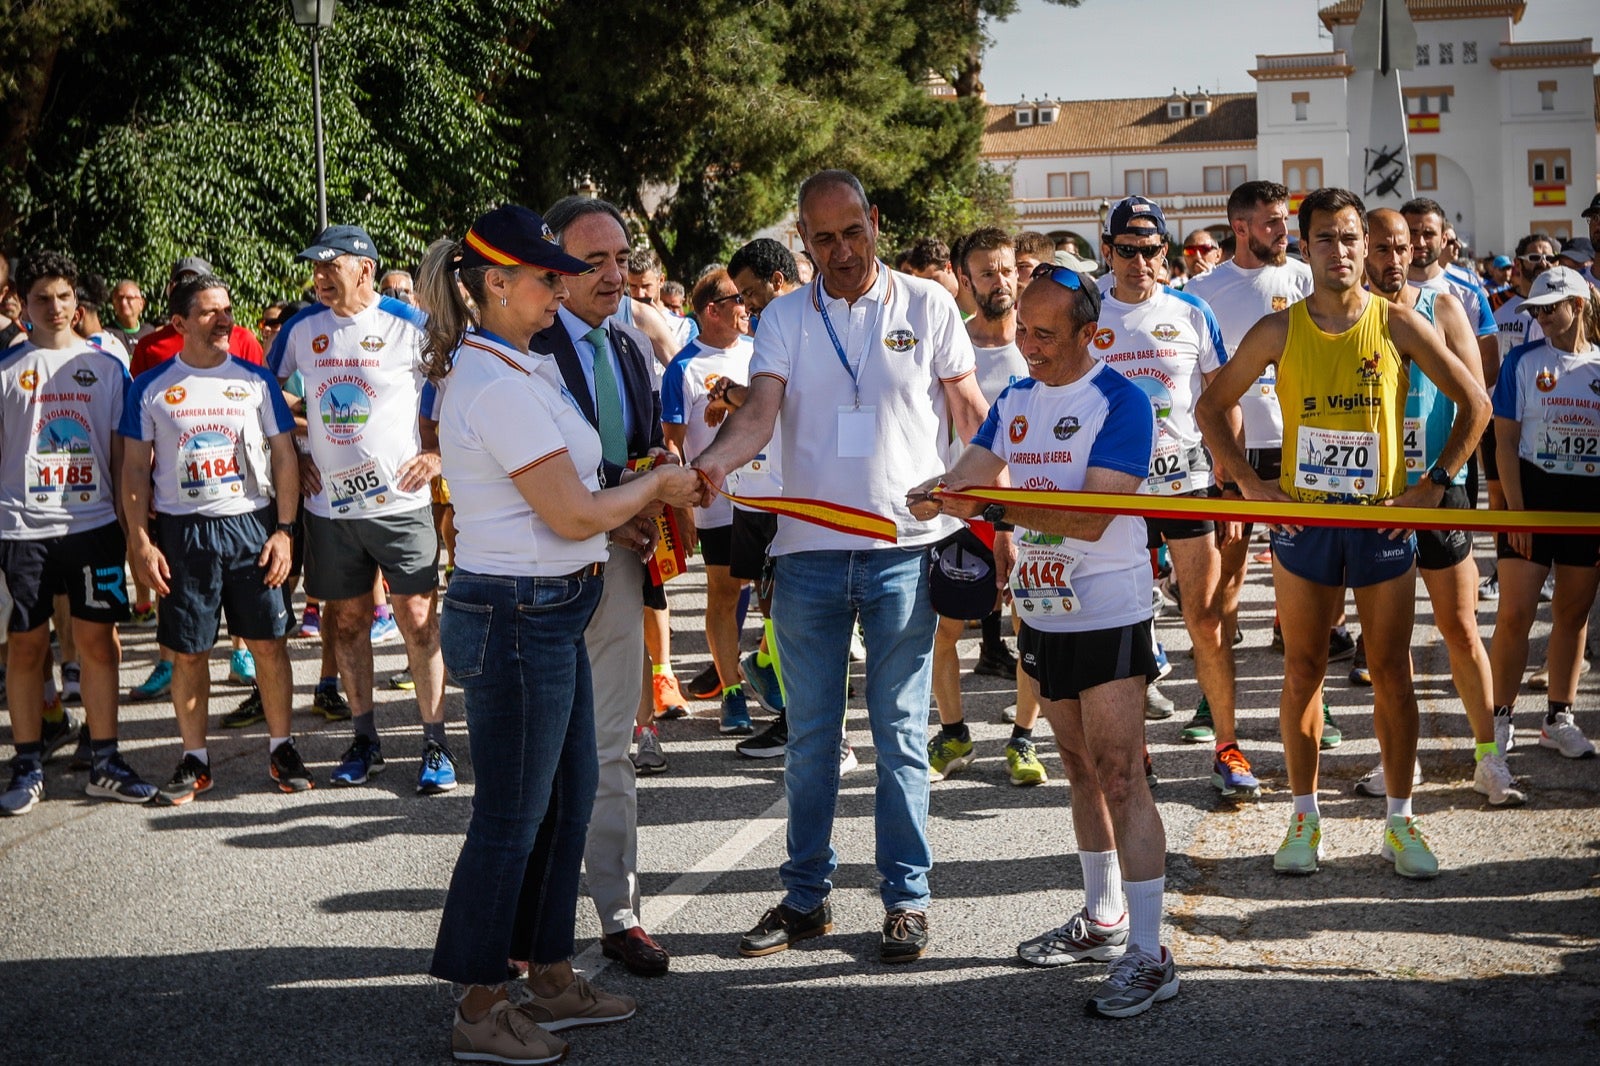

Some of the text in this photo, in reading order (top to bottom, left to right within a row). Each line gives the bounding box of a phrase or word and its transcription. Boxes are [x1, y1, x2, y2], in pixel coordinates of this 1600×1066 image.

[1498, 320, 1523, 332] anada
[319, 359, 343, 368] CARRERA
[345, 359, 359, 367] BASE
[361, 359, 380, 368] AEREA
[1105, 352, 1136, 363] CARRERA
[1137, 350, 1154, 359] BASE
[1156, 349, 1177, 358] AEREA
[1123, 368, 1176, 390] OLANTONES"
[1328, 394, 1381, 411] Vigilsa
[1547, 397, 1574, 406] CARRERA
[1576, 399, 1590, 408] BASE
[176, 409, 206, 418] CARRERA
[208, 408, 224, 416] BASE
[1562, 436, 1597, 455] 192
[1324, 445, 1368, 467] 270
[40, 466, 93, 486] 1185
[187, 456, 240, 481] 1184
[343, 470, 380, 495] 305
[1020, 561, 1067, 588] 1142
